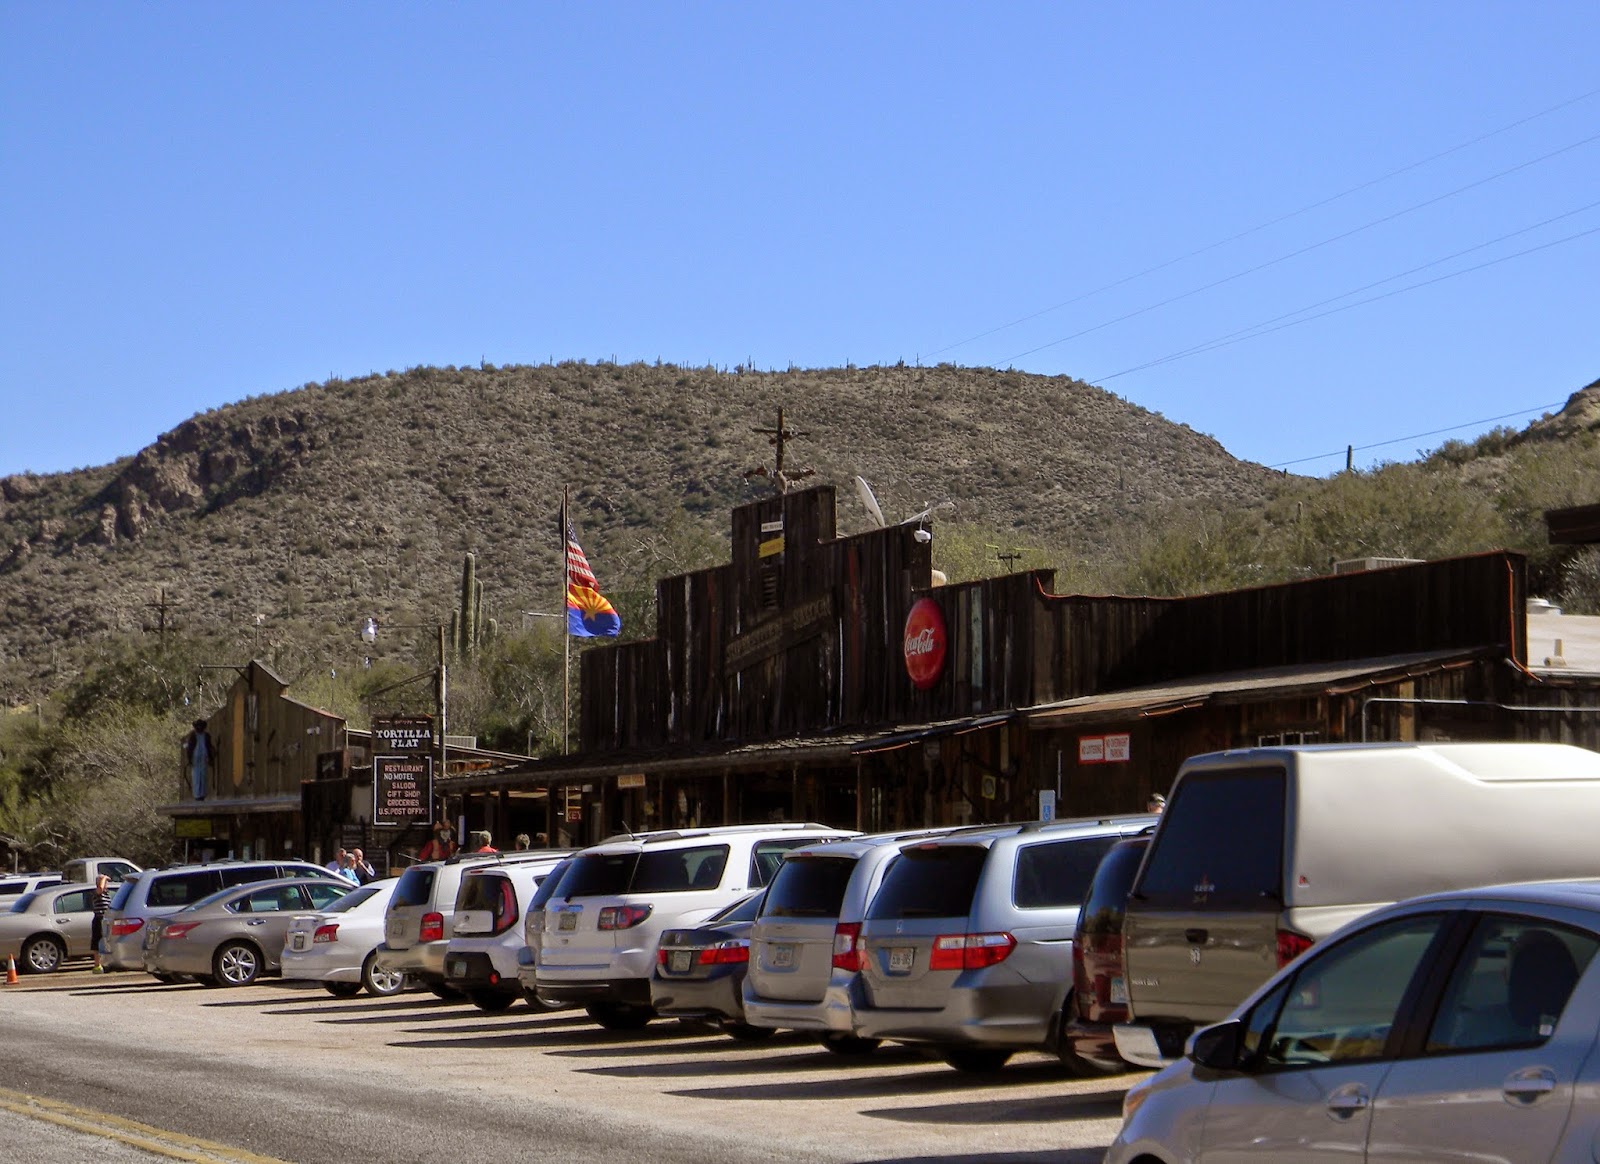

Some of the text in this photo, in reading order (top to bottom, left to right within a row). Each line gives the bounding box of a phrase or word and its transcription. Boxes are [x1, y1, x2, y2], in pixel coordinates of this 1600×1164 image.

[375, 729, 431, 739] TORTILLA
[390, 738, 419, 748] FLAT
[384, 764, 424, 772] RESTAURANT
